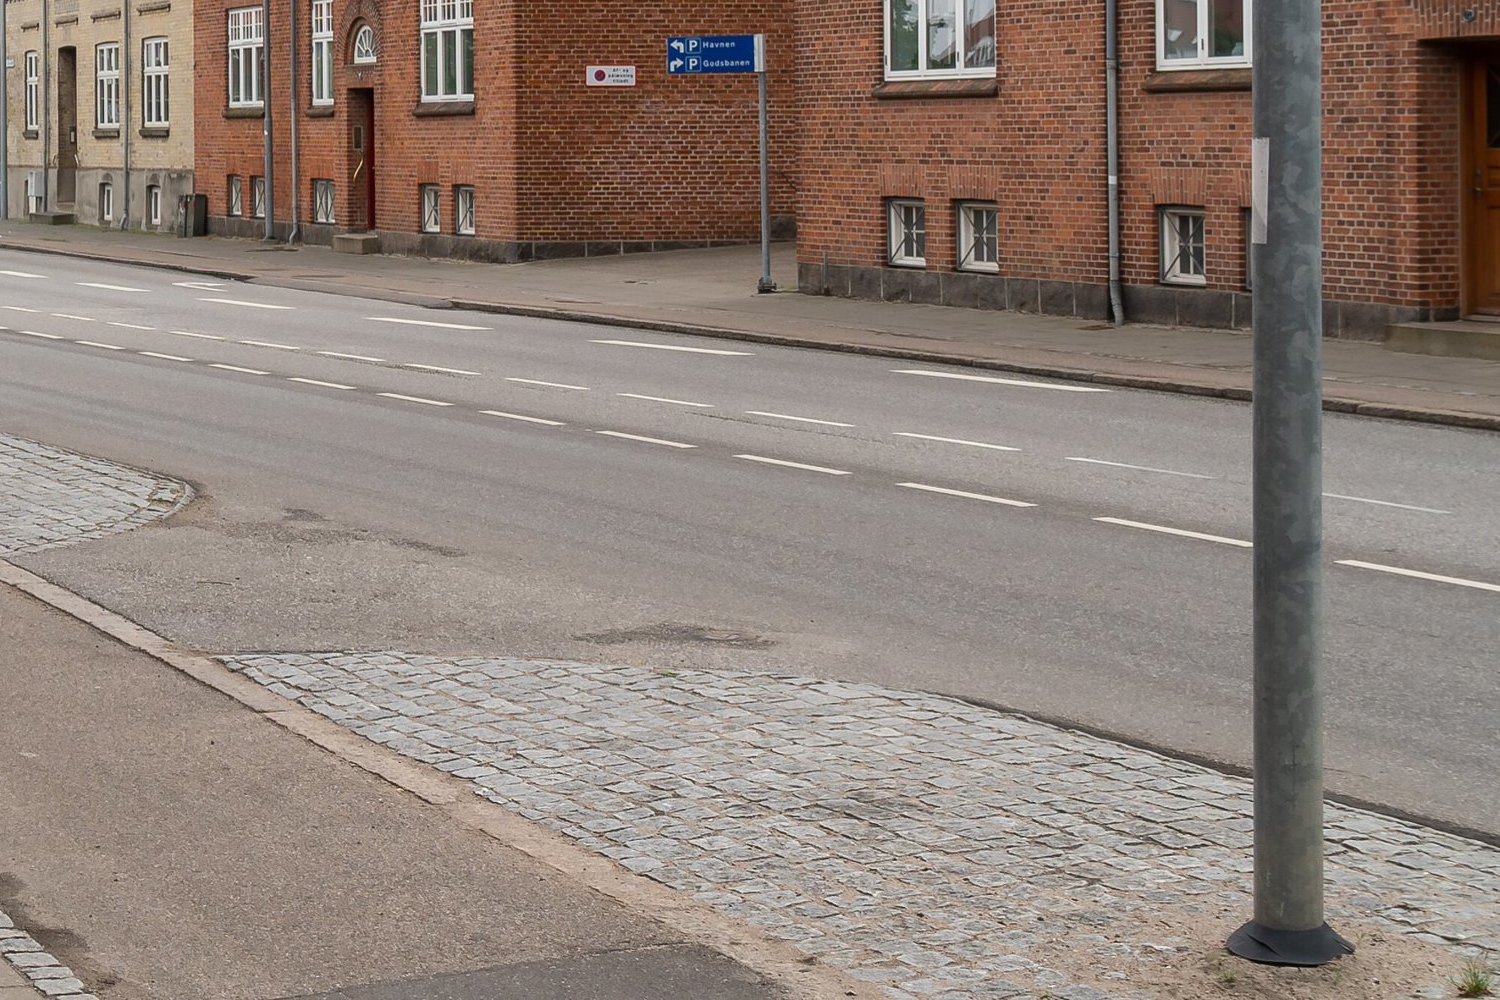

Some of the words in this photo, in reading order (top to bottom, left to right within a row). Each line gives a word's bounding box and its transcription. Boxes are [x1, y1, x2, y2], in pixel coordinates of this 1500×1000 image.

[689, 40, 698, 51] P
[702, 41, 736, 49] Havnen
[689, 58, 698, 70] P
[702, 59, 750, 67] Godsbanen
